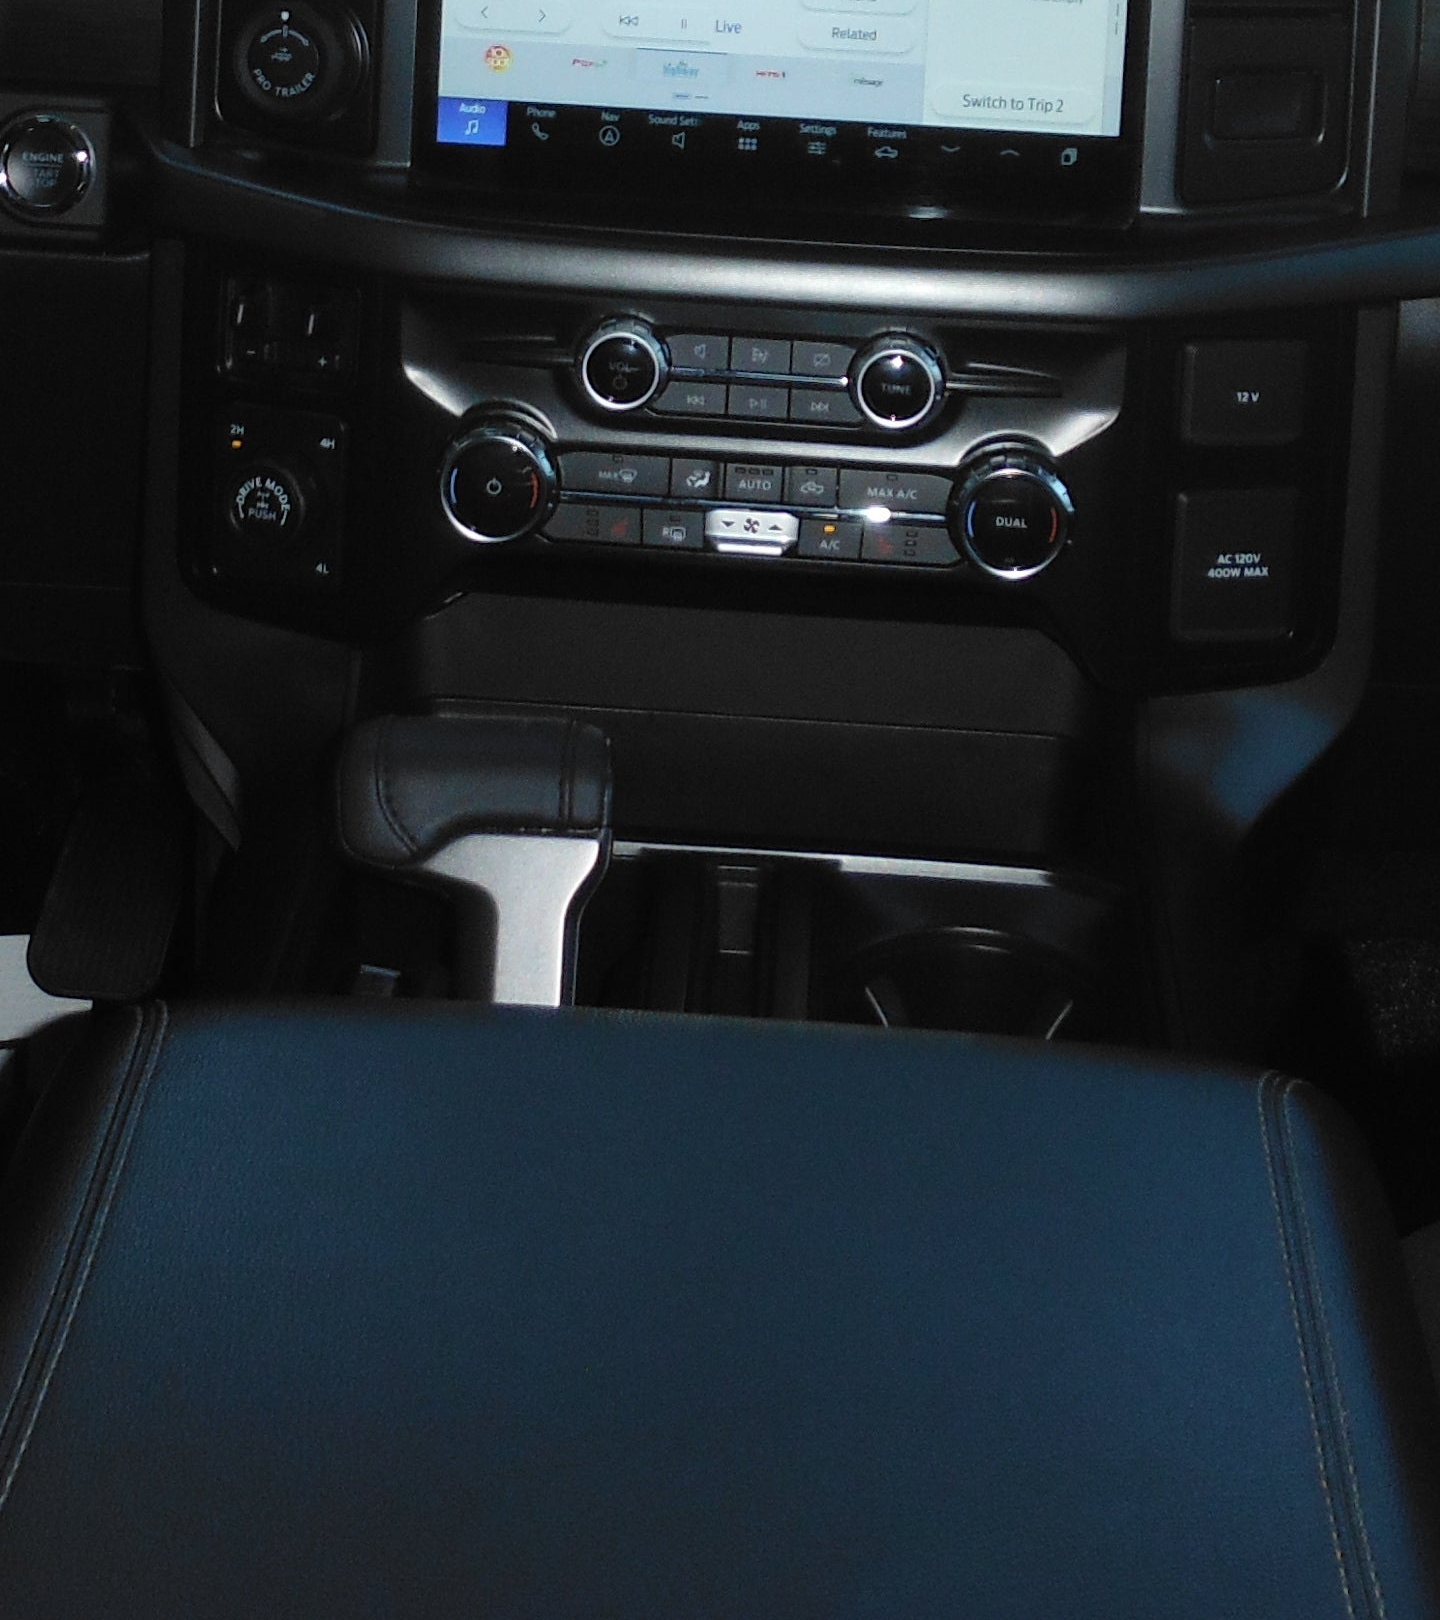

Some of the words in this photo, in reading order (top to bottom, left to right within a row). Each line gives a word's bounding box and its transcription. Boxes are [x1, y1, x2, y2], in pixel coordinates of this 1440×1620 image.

[715, 19, 742, 34] Live
[831, 26, 877, 41] Related
[253, 68, 272, 91] PRO
[275, 72, 316, 97] TRAILER
[459, 101, 487, 115] Audio
[962, 93, 1007, 110] Switch
[1010, 98, 1024, 111] to
[1027, 97, 1054, 114] Trip
[1055, 99, 1064, 113] 2
[526, 106, 557, 119] Phone
[601, 111, 620, 123] Nav
[648, 113, 678, 127] Sound
[737, 119, 761, 132] Apps
[799, 122, 837, 137] Settings
[867, 126, 907, 140] Features
[22, 149, 65, 163] ENGINE
[882, 382, 912, 395] TUNE
[230, 423, 246, 436] 2H
[319, 436, 336, 450] 4H
[738, 479, 772, 491] AUTO
[235, 476, 262, 506] DRIVE
[264, 477, 292, 512] MODE
[867, 487, 894, 498] MAX
[896, 488, 918, 500] A/C
[248, 506, 278, 522] PUSH
[995, 516, 1028, 529] DUAL
[819, 539, 841, 551] A/C
[1217, 553, 1233, 565] AC
[1235, 552, 1261, 565] 120V
[1207, 567, 1241, 579] 400W
[1244, 566, 1269, 578] MAX
